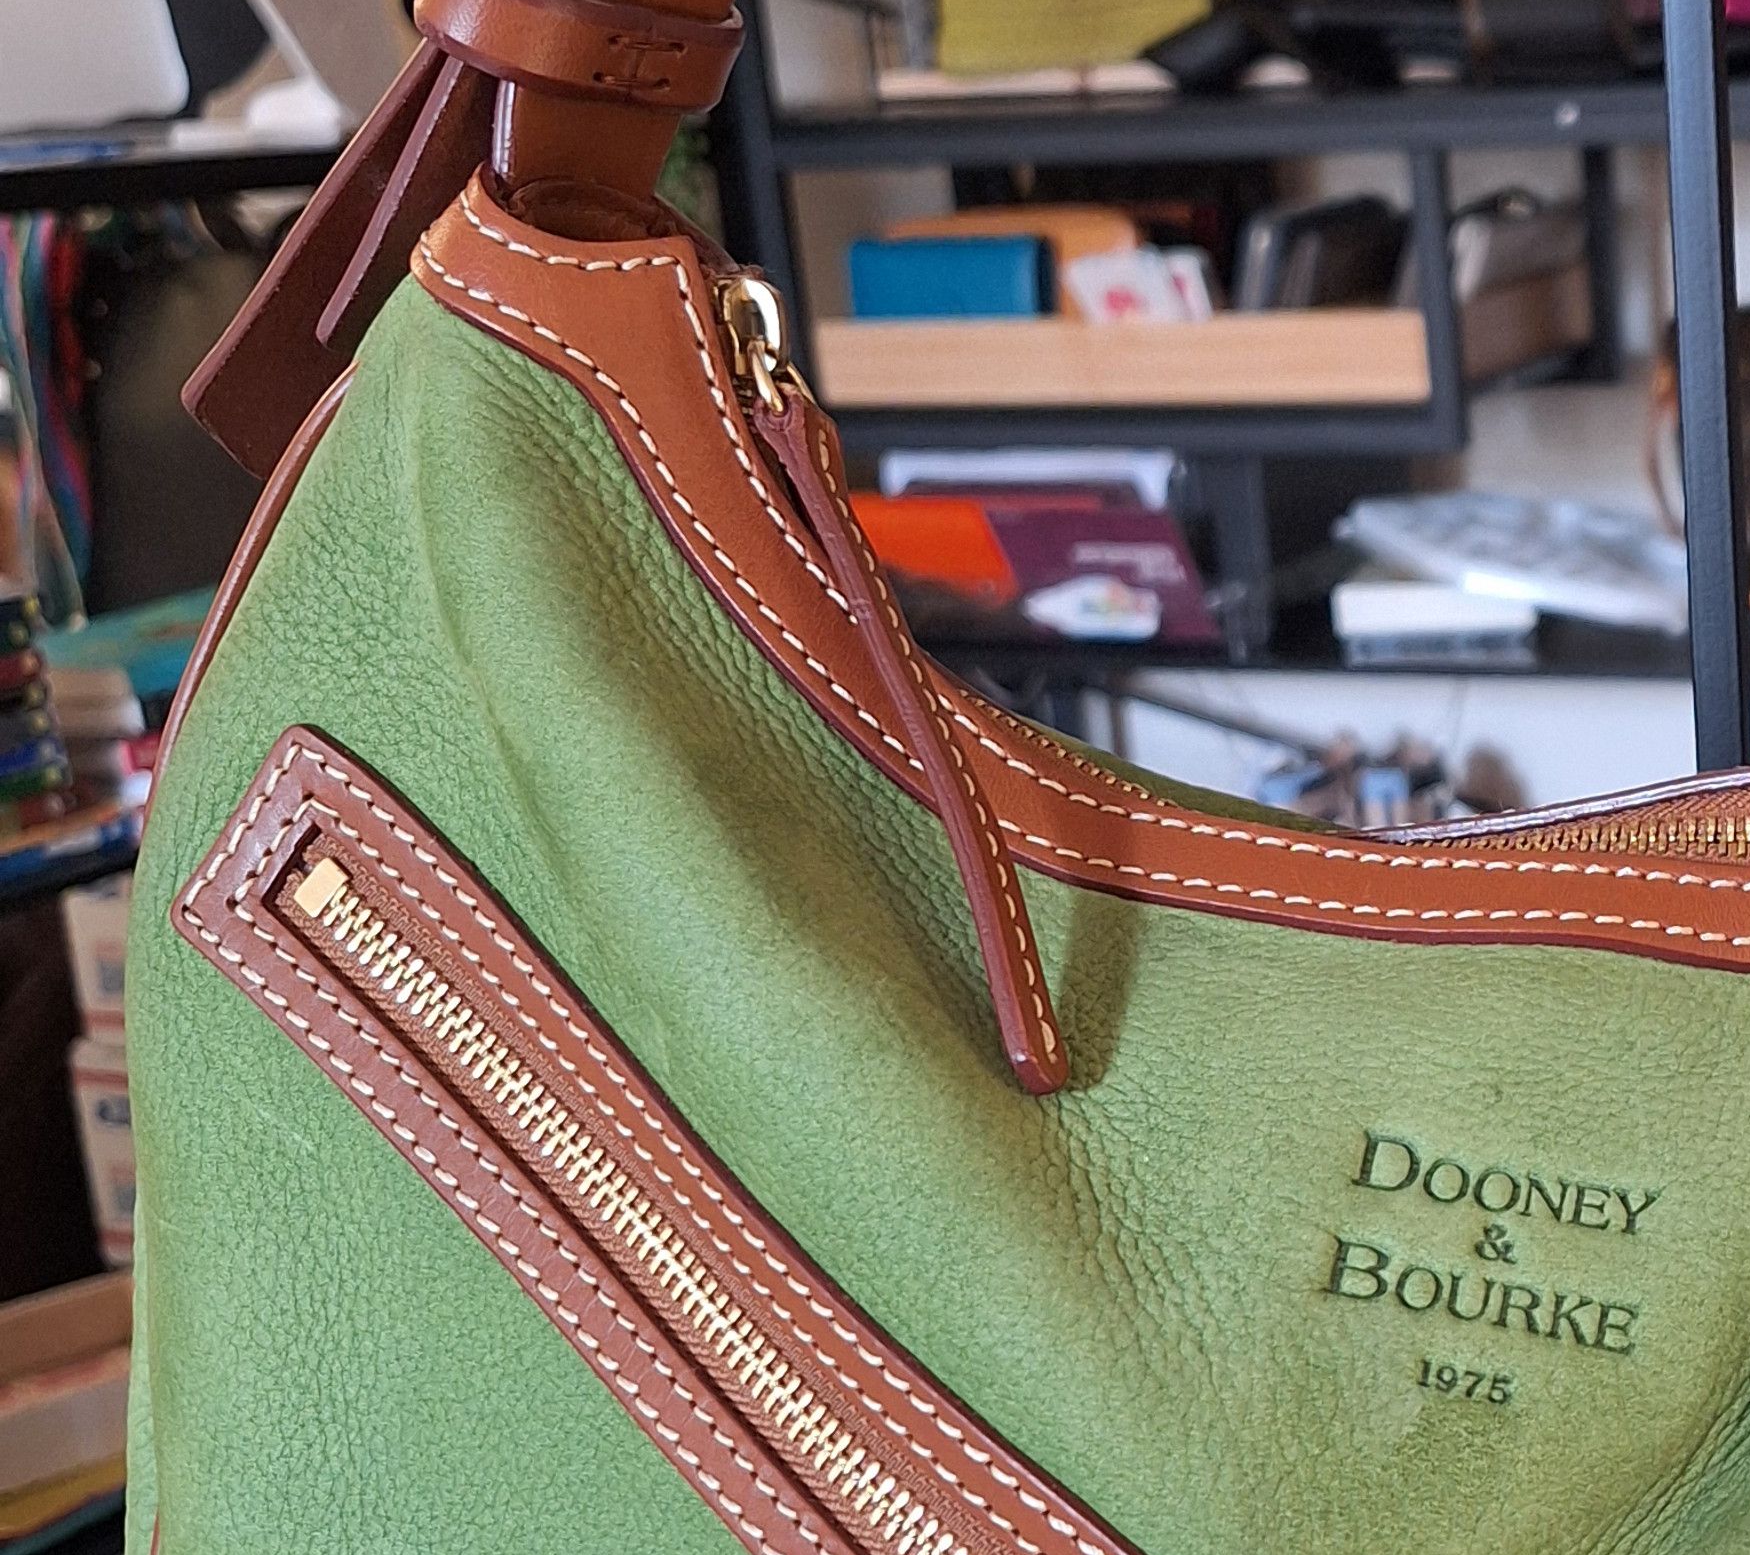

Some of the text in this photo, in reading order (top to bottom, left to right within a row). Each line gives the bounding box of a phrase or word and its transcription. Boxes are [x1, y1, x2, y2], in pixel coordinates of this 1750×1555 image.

[1352, 1130, 1658, 1235] DOONEY
[1474, 1223, 1518, 1264] &
[1324, 1236, 1640, 1355] BOURKE
[1416, 1357, 1513, 1406] 1975
